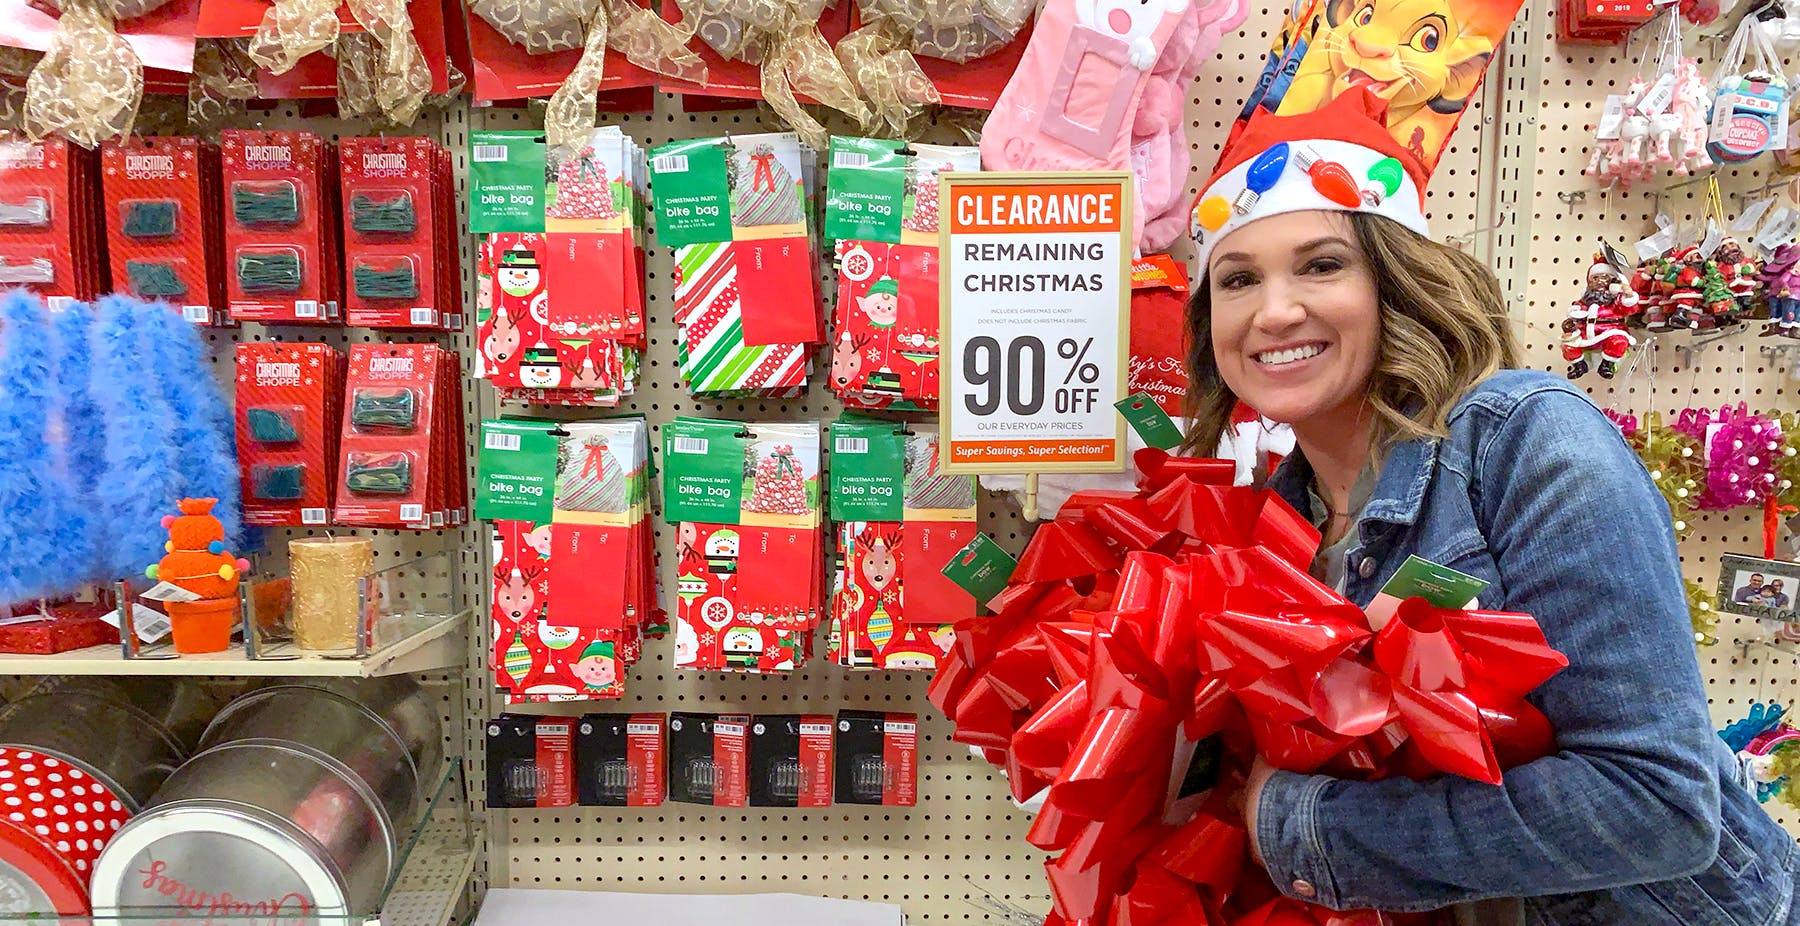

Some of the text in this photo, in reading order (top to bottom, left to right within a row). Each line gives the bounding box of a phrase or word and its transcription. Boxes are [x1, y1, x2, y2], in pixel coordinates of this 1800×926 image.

[245, 145, 292, 162] CHRISTMAS
[362, 152, 408, 169] CHRISTMAS
[125, 155, 174, 171] CHRISTMAS
[246, 162, 292, 171] SHOPPE
[126, 170, 175, 180] SHOPPE
[362, 168, 408, 178] SHOPPE
[481, 194, 535, 206] bike bag
[664, 196, 700, 205] CHRISTMAS
[839, 192, 892, 202] CHRISTMAS PARTY
[666, 204, 720, 218] bike bag
[838, 200, 892, 216] bike bag
[957, 193, 1114, 226] CLEARANCE
[568, 238, 577, 262] From:
[596, 239, 604, 252] To:
[782, 245, 790, 258] To:
[964, 242, 1104, 262] REMAINING
[754, 247, 764, 272] From:
[922, 252, 931, 278] From:
[964, 274, 1104, 292] CHRISTMAS
[256, 362, 301, 378] CHRISTMAS
[369, 356, 414, 372] CHRISTMAS
[256, 378, 300, 387] SHOPPE
[368, 371, 412, 380] SHOPPE
[1055, 388, 1100, 414] OFF
[977, 422, 1084, 430] OUR EVERYDAY PRICES
[956, 447, 984, 457] Super
[986, 446, 1026, 458] Savings,
[1028, 446, 1056, 456] Super
[490, 474, 526, 482] CHRISTMAS
[679, 476, 714, 484] CHRISTMAS
[489, 482, 544, 496] bike bag
[678, 484, 731, 498] bike bag
[842, 485, 893, 496] bike bag
[600, 532, 608, 545] To:
[788, 534, 796, 546] To:
[922, 528, 930, 552] From:
[950, 528, 958, 540] To:
[572, 531, 580, 554] From:
[761, 532, 769, 554] From:
